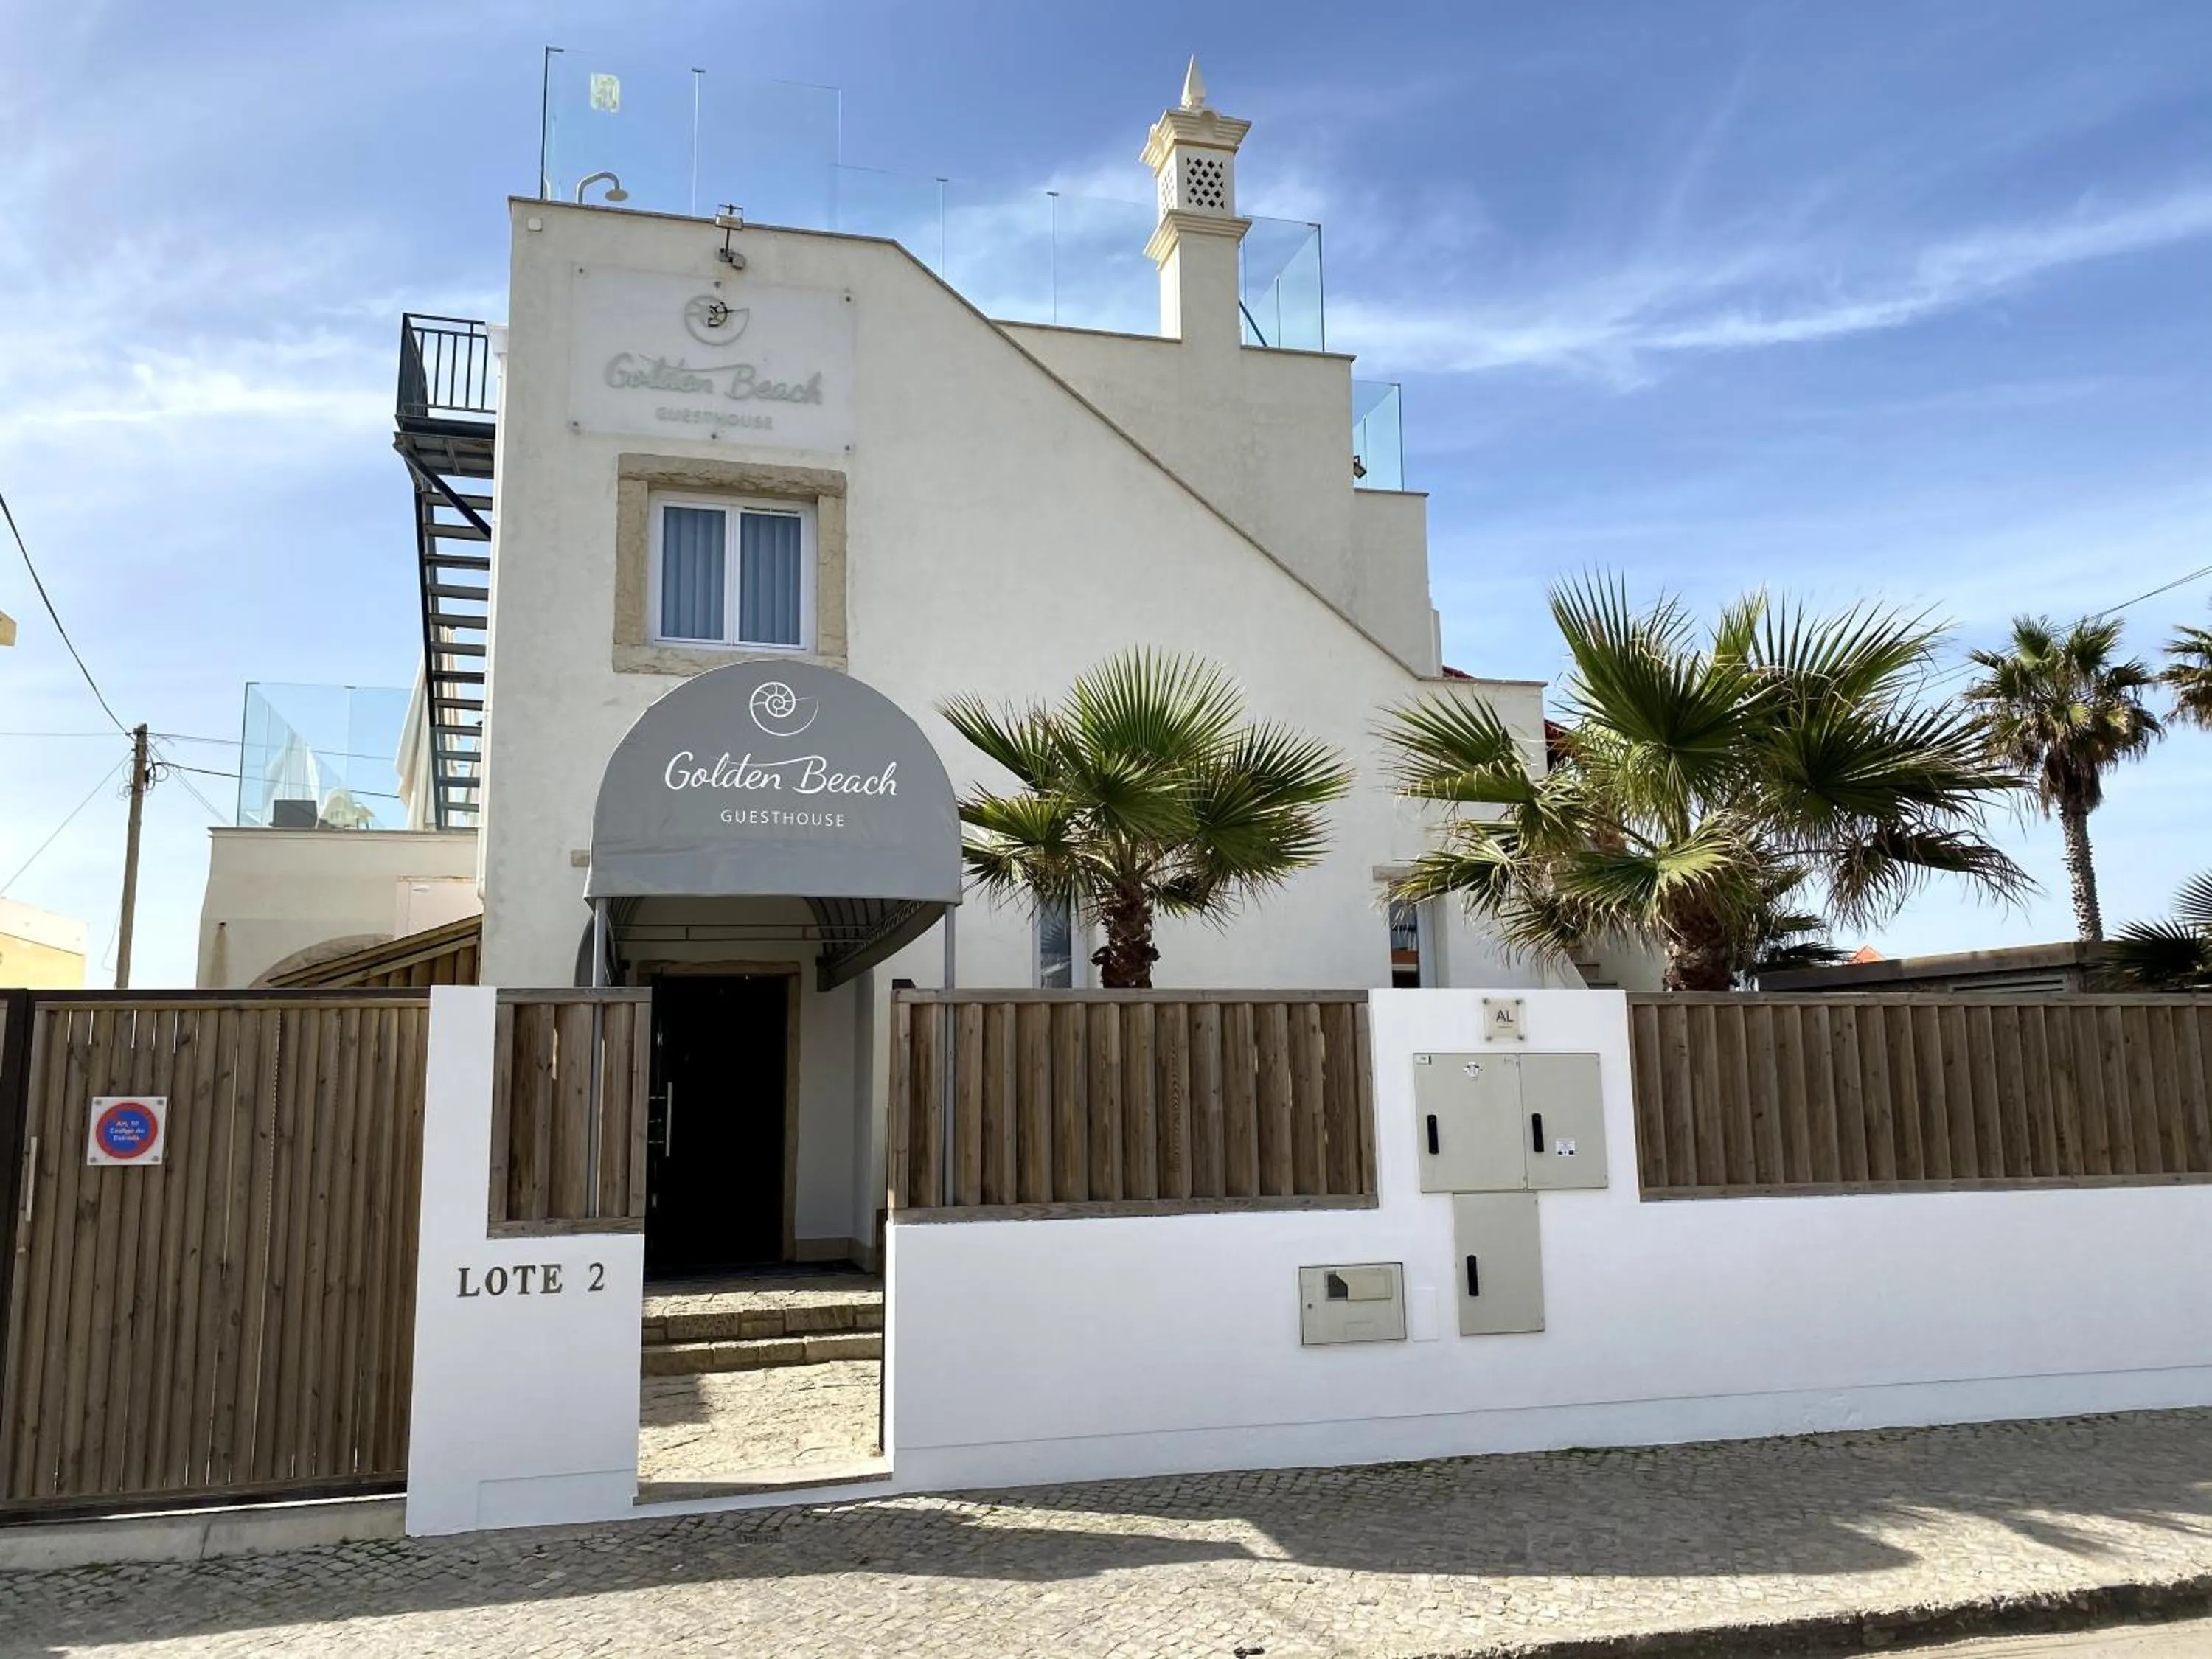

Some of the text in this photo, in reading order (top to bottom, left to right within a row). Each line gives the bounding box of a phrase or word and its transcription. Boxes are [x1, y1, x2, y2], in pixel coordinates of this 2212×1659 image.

[604, 352, 822, 404] Golden Beach
[656, 406, 773, 430] GUESTHOUSE
[664, 751, 897, 796] Golden Beach
[720, 810, 844, 827] GUESTHOUSE
[1496, 1009, 1514, 1023] AL
[457, 1262, 605, 1298] LOTE 2
